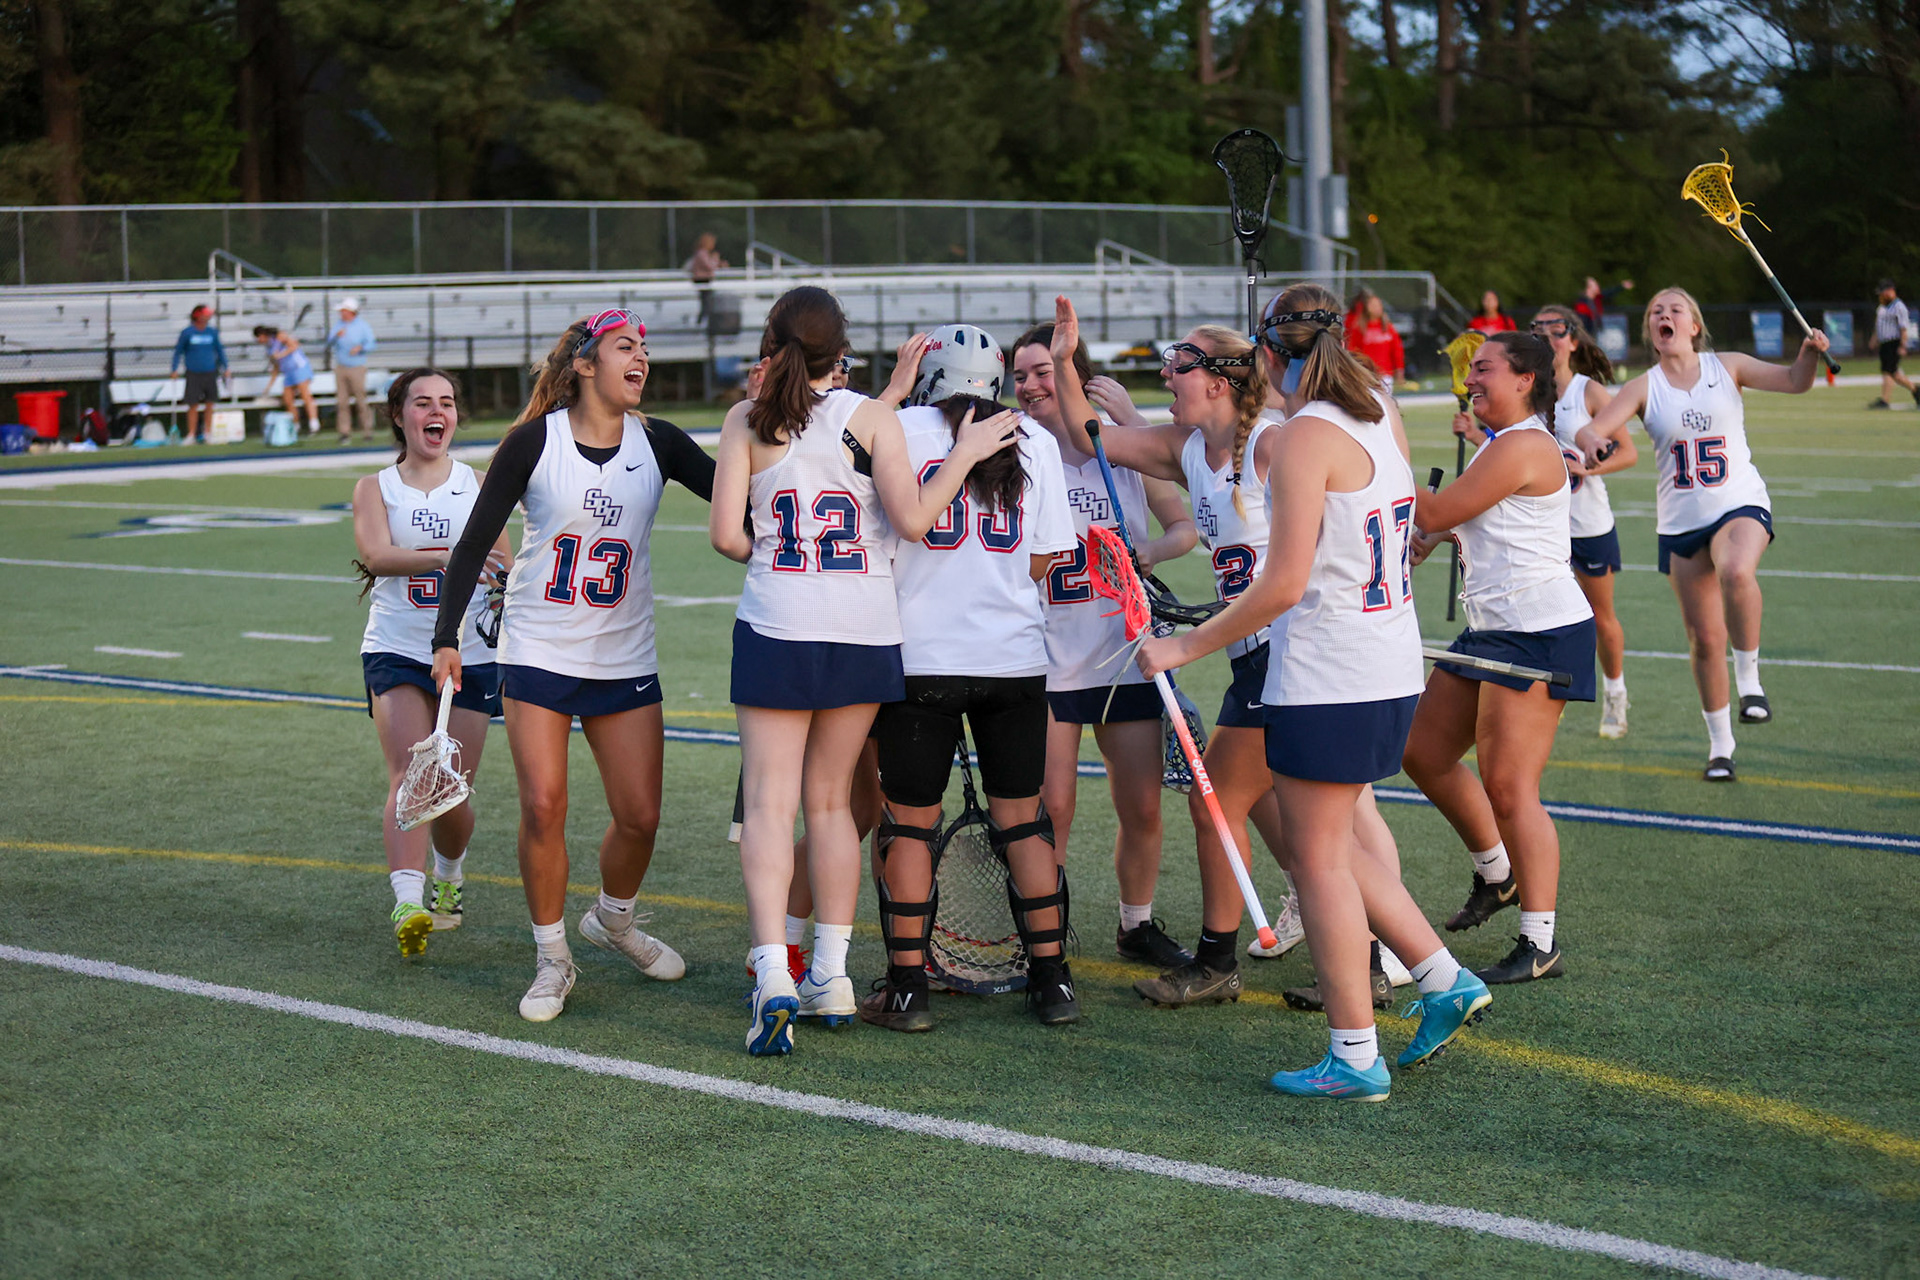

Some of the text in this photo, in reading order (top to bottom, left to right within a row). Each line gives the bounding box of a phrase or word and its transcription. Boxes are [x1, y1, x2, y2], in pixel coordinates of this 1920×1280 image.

[1270, 313, 1294, 324] STX
[1214, 358, 1243, 366] STX
[1670, 435, 1729, 489] 15
[582, 488, 624, 527] SBA
[1067, 487, 1109, 521] SBA
[1197, 497, 1218, 537] SBA
[412, 508, 450, 539] SBA
[771, 488, 869, 574] 12
[544, 532, 633, 609] 13
[1361, 496, 1415, 613] 17
[892, 992, 914, 1012] N
[993, 984, 1011, 994] STX
